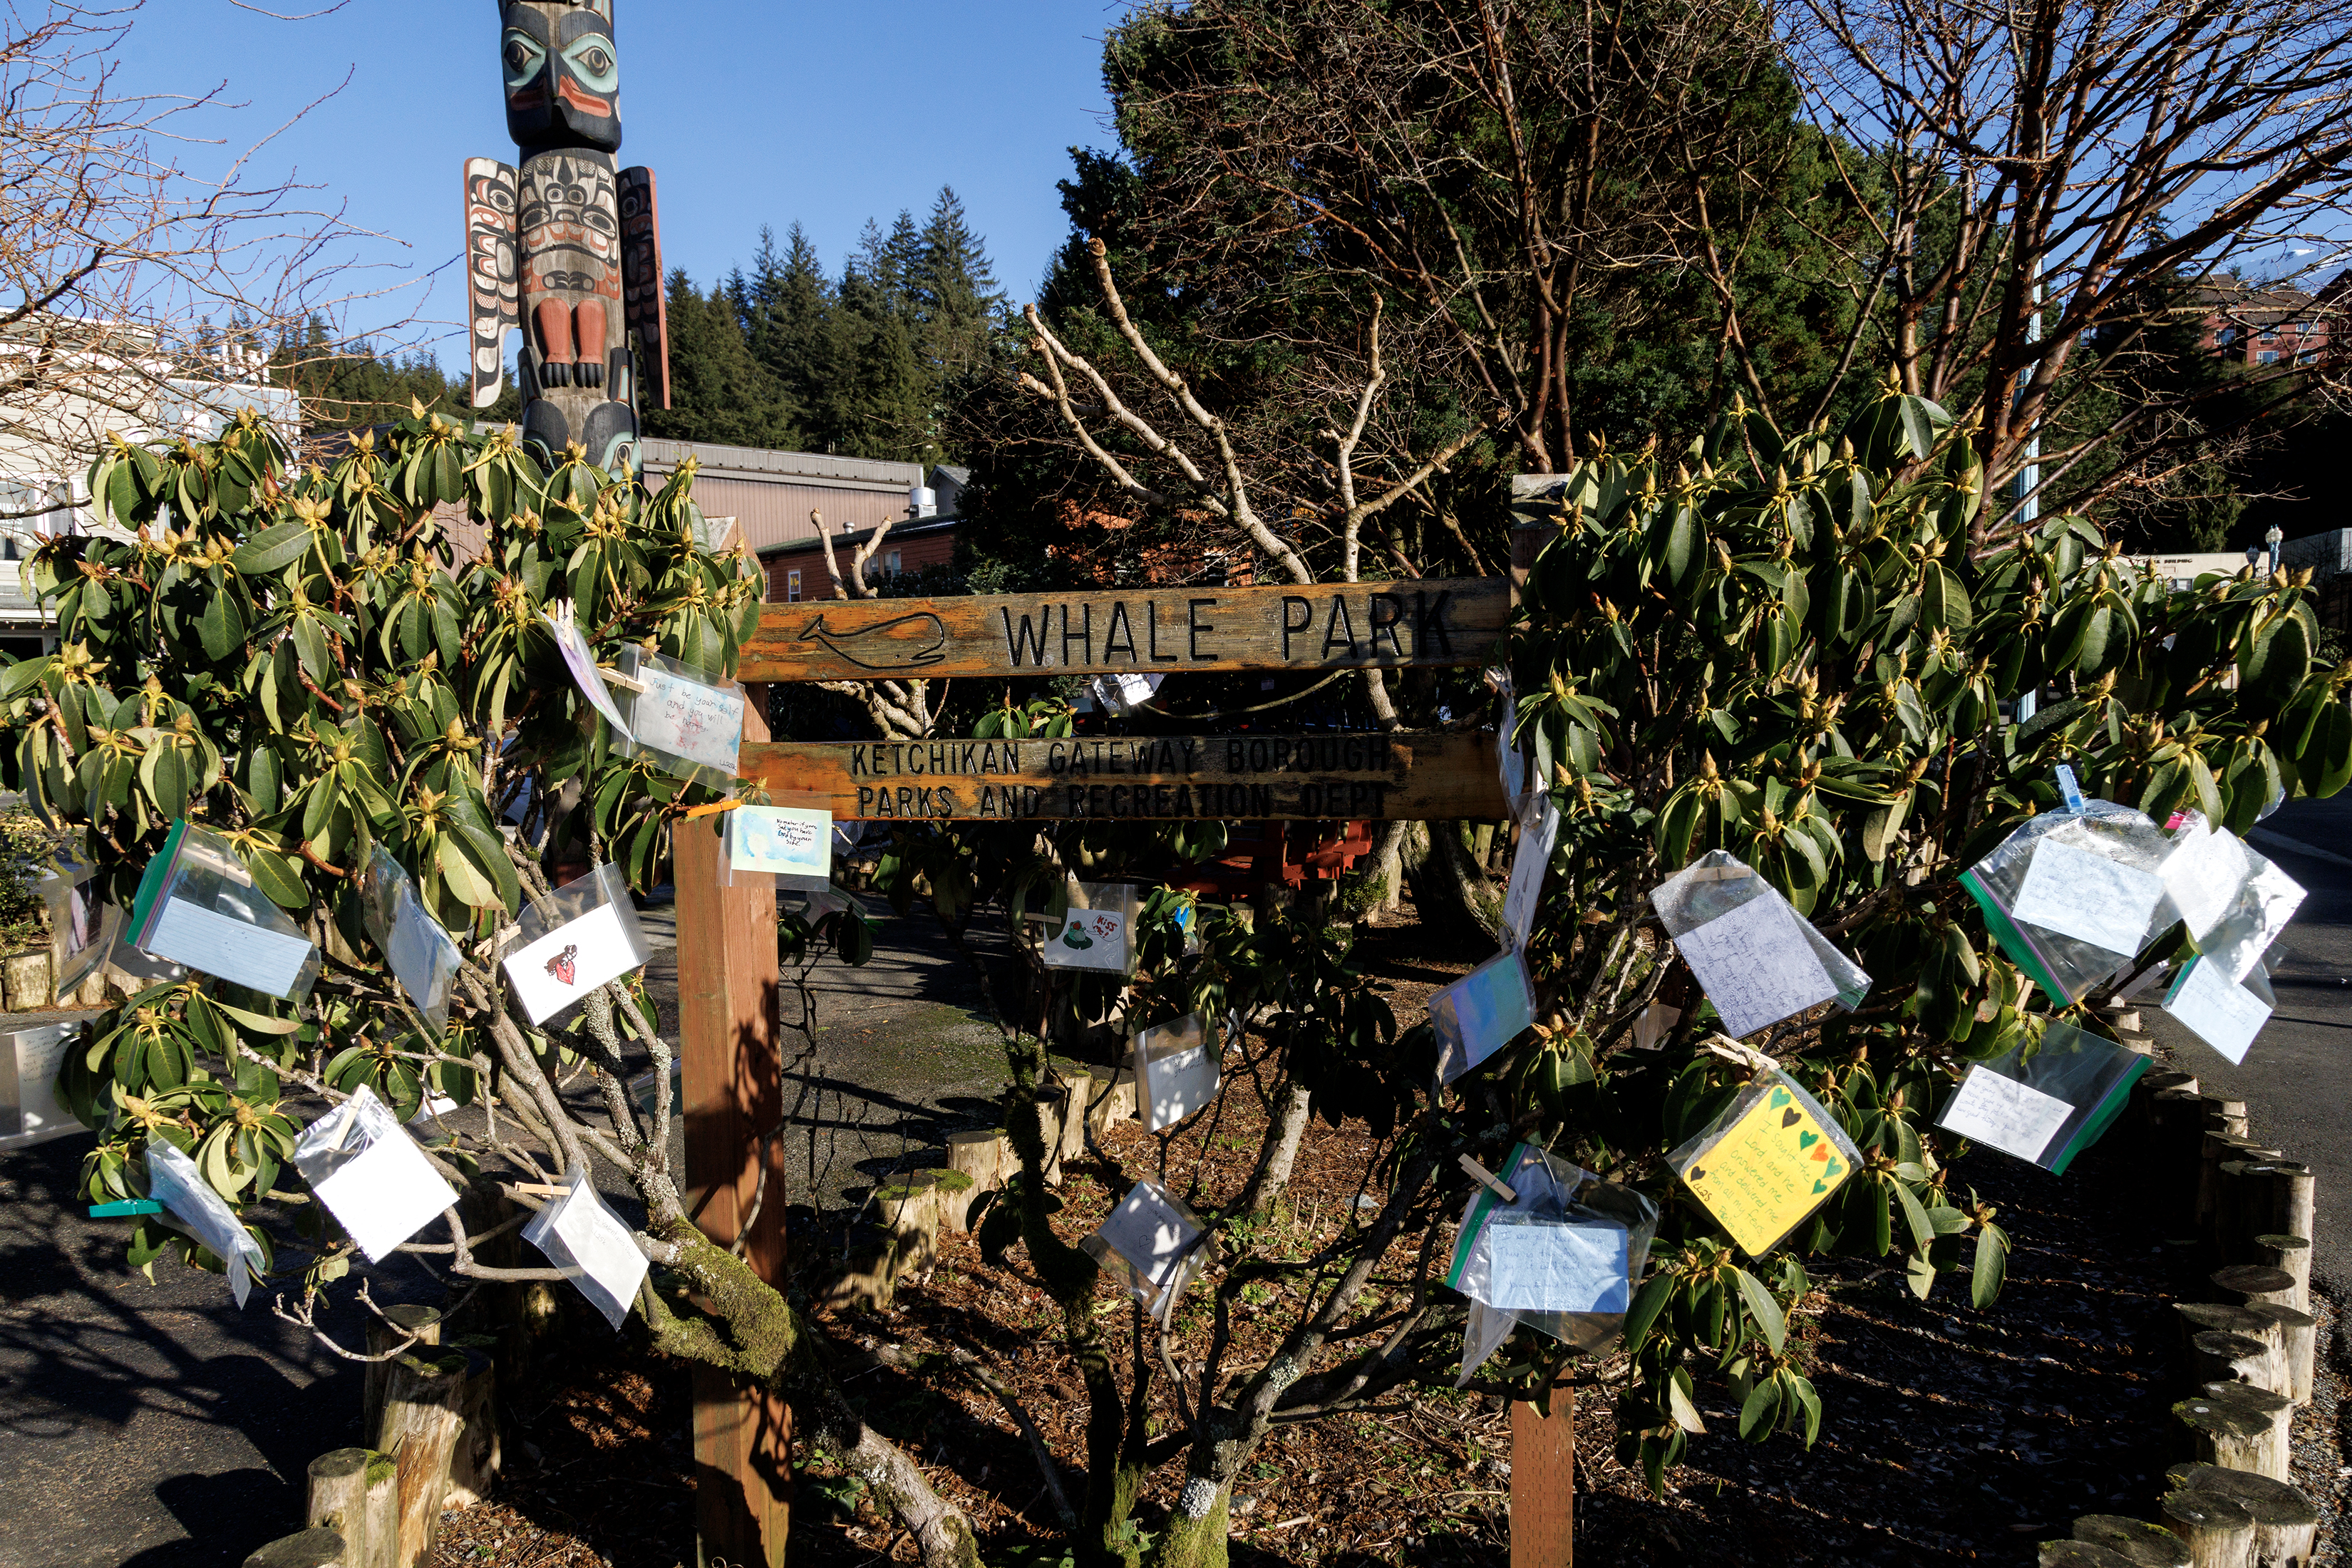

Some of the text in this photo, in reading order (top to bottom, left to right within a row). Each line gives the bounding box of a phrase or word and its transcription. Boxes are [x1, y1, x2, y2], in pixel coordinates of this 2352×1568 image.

[1001, 589, 1452, 666] WHALE PARK
[650, 677, 674, 692] Just
[681, 688, 691, 699] be
[664, 711, 708, 732] be happy.
[666, 700, 723, 725] and you will
[852, 738, 1387, 775] KETCHIKAN GATEWAY BOROUGH
[857, 783, 1387, 818] PARKS AND RECREATION DEPT
[1172, 1063, 1190, 1078] your
[1745, 1133, 1794, 1193] Lord, and he
[1759, 1120, 1773, 1134] I
[1799, 1162, 1810, 1183] the
[1719, 1162, 1778, 1224] and delivered me
[1731, 1150, 1782, 1204] answered me
[1709, 1169, 1765, 1237] from all my fears.
